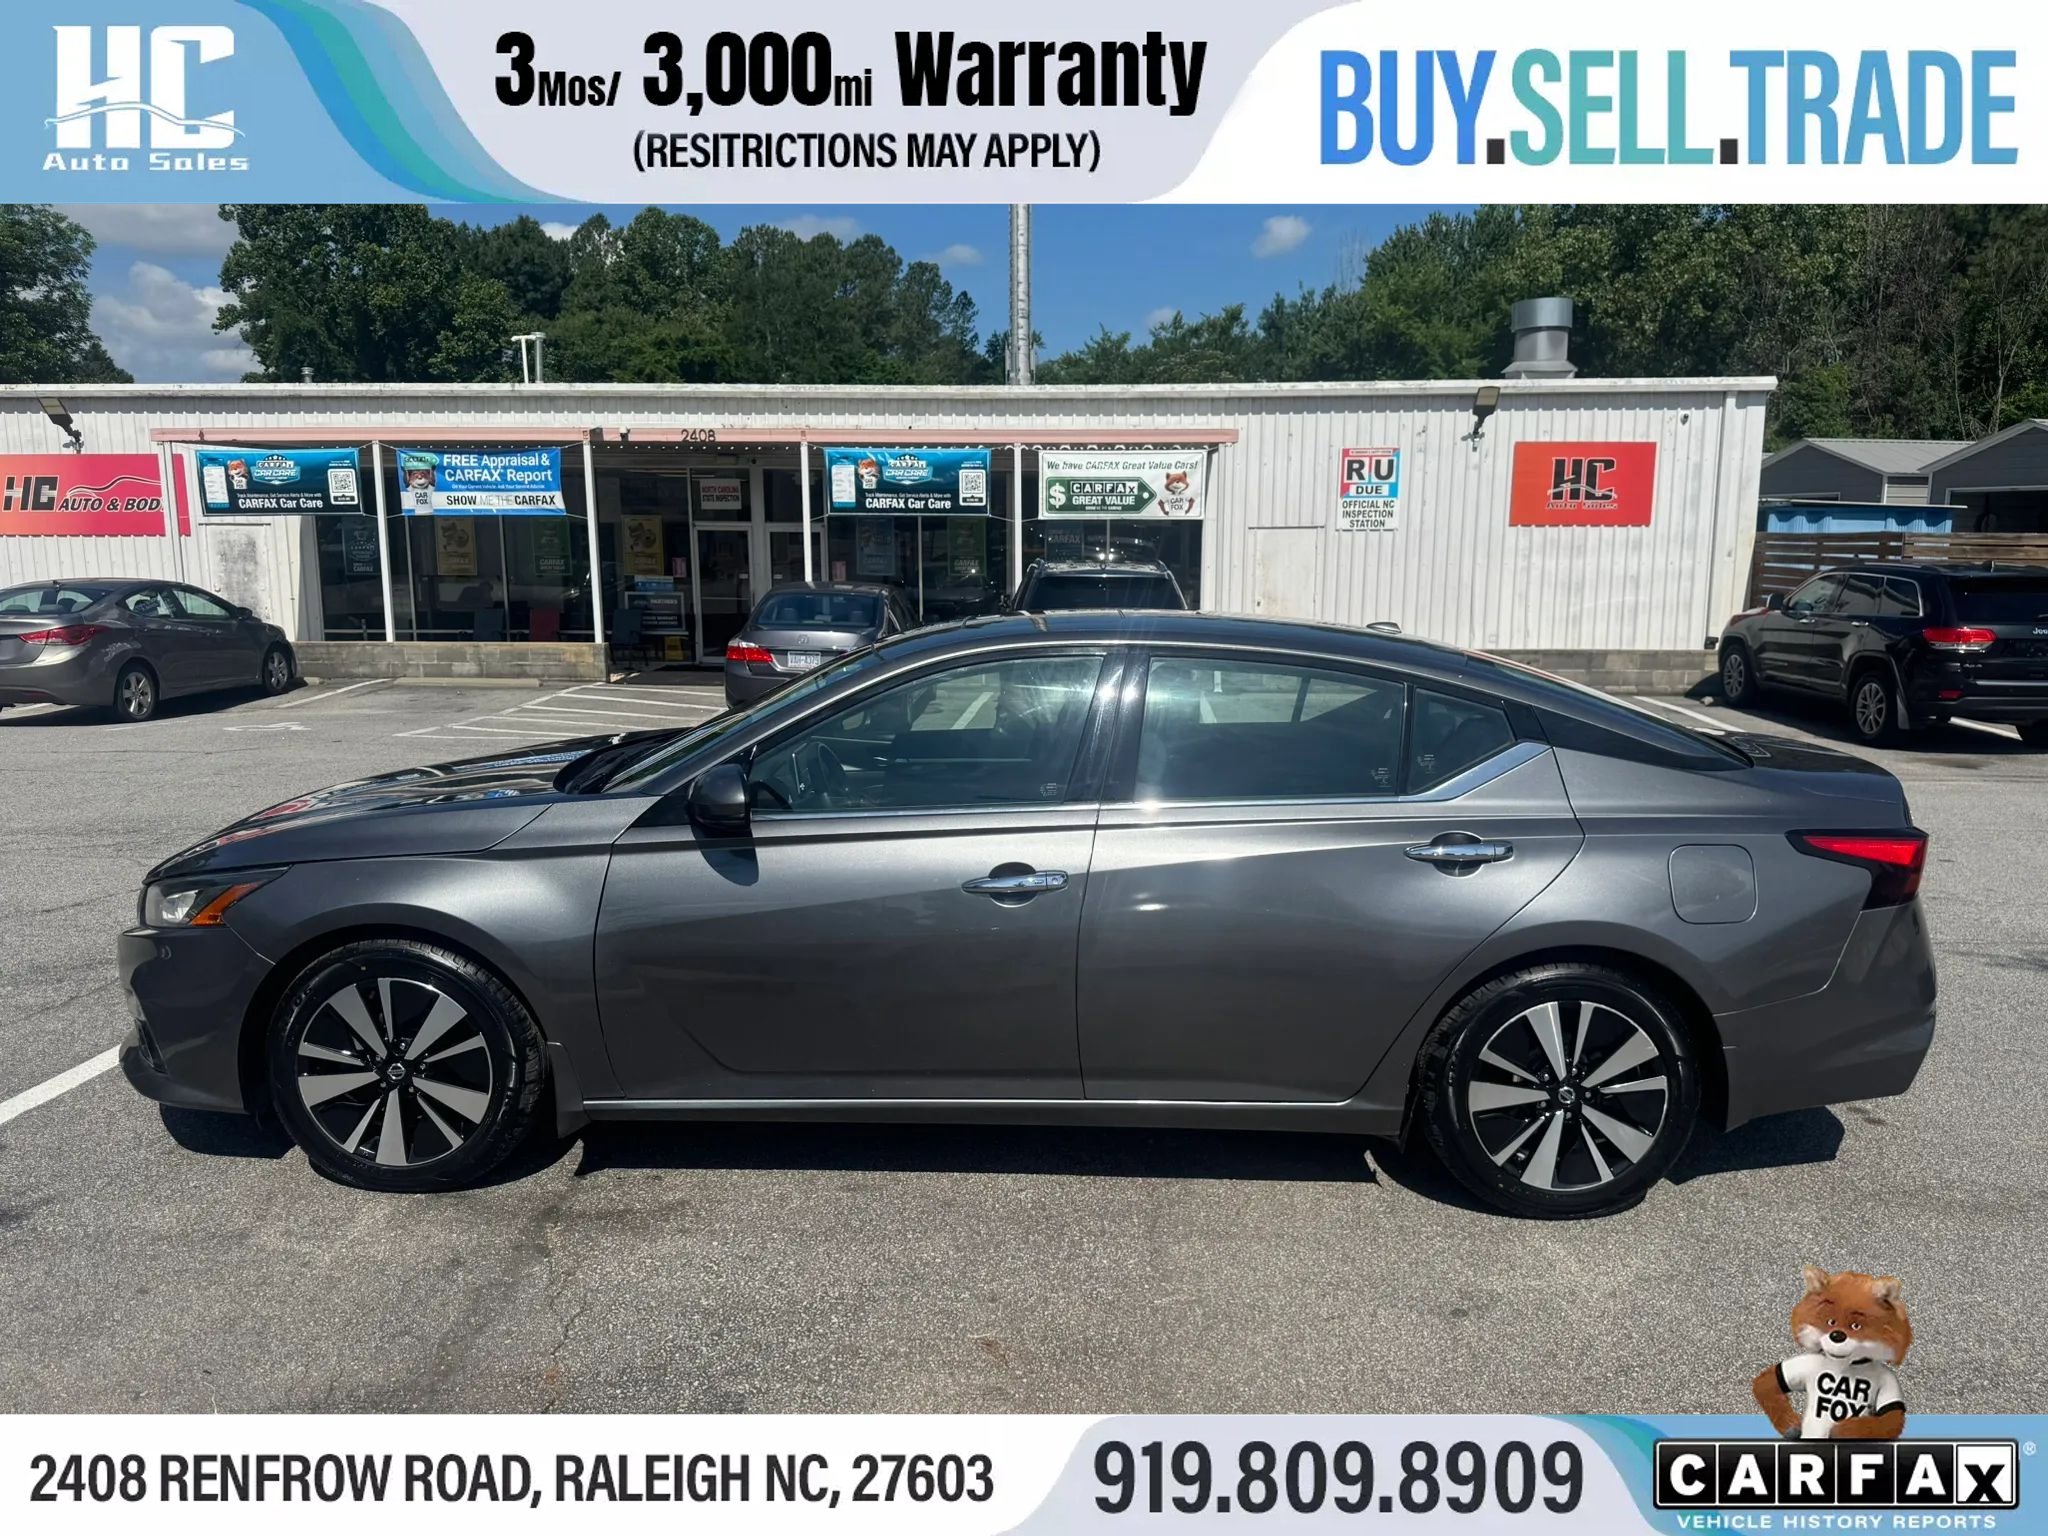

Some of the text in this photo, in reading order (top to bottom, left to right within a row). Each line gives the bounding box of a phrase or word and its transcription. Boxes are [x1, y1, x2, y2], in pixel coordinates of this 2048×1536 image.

[681, 429, 716, 442] 2408
[443, 454, 479, 467] FREE
[481, 453, 539, 469] Appraisal
[541, 453, 550, 466] &
[1047, 460, 1199, 470] We have CARFAX Great Value Cars!
[1346, 459, 1395, 481] R U
[444, 468, 553, 484] CARFAX Report
[1550, 456, 1617, 502] HC
[3, 475, 165, 513] HC AUTO & BOD
[1072, 482, 1136, 495] CARFAX
[1356, 485, 1383, 495] DUE
[446, 495, 556, 506] SHOW ME THE CARFAX
[1049, 483, 1067, 509] $
[1072, 496, 1136, 506] GREAT VALUE
[238, 498, 278, 509] CARFAX
[280, 498, 297, 509] Car
[299, 498, 324, 509] Care
[865, 498, 906, 509] CARFAX
[908, 498, 926, 509] Car
[928, 498, 952, 509] Care
[1342, 500, 1395, 509] OFFICIAL NC
[1342, 510, 1394, 519] INSPECTION
[1349, 519, 1386, 528] STATION
